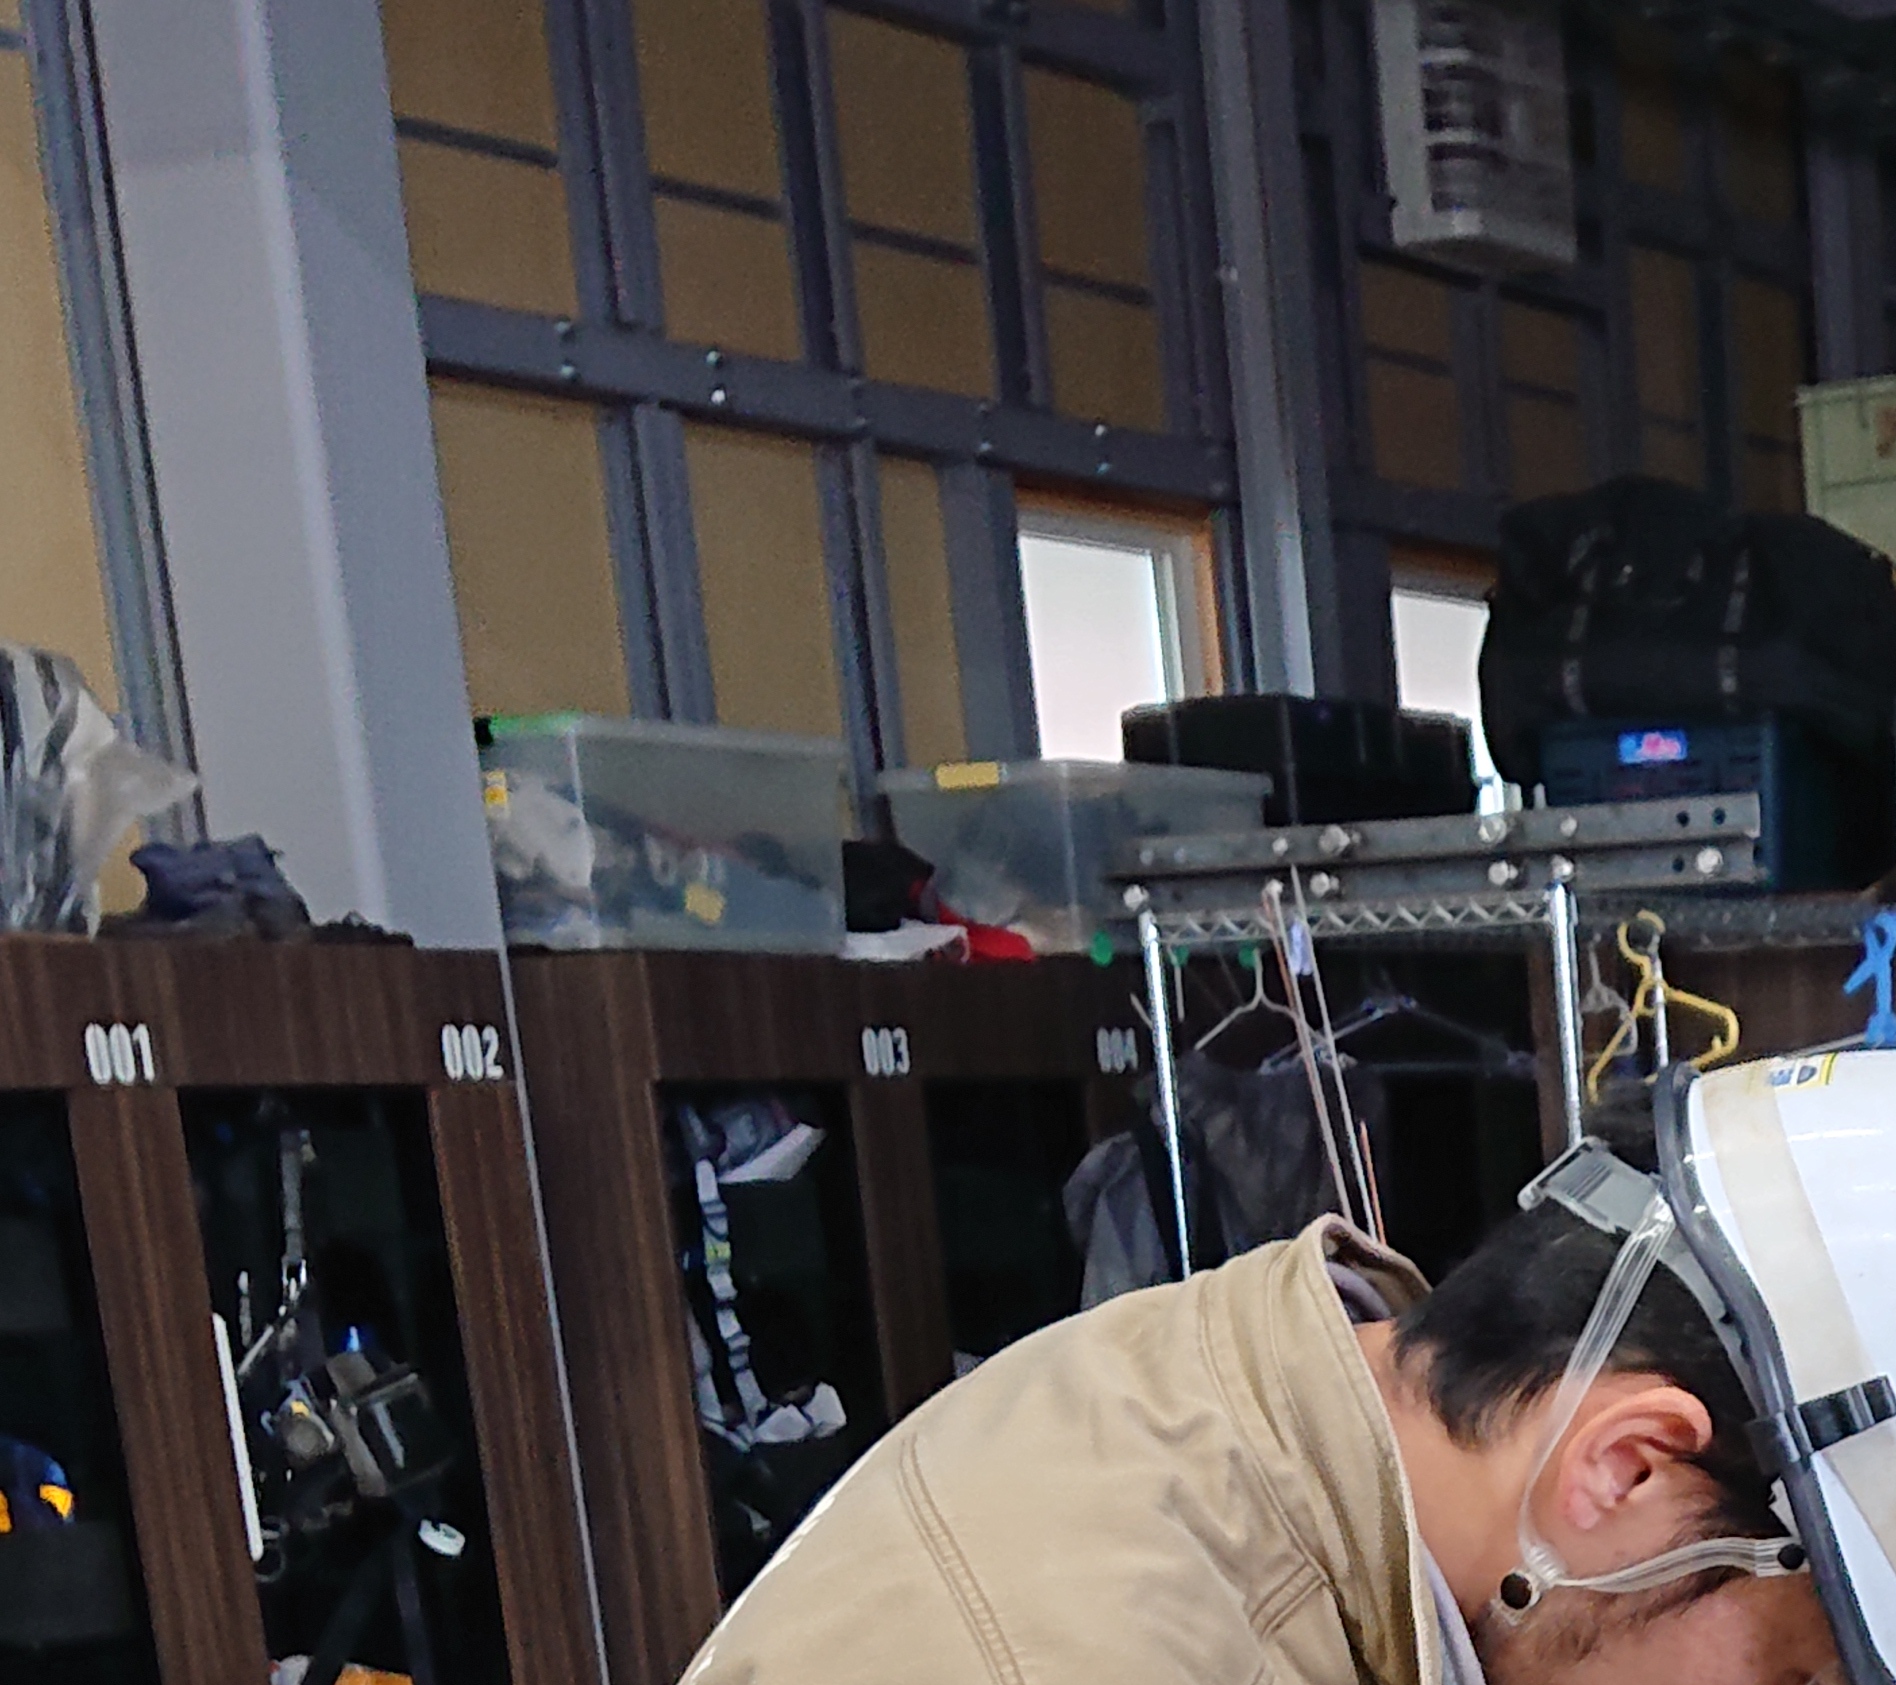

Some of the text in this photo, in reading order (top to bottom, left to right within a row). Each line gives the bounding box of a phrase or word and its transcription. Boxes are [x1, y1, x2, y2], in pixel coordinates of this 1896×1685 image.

[85, 1023, 155, 1085] 001
[442, 1024, 503, 1081] 002
[862, 1026, 910, 1076] 003
[1097, 1026, 1138, 1074] 004
